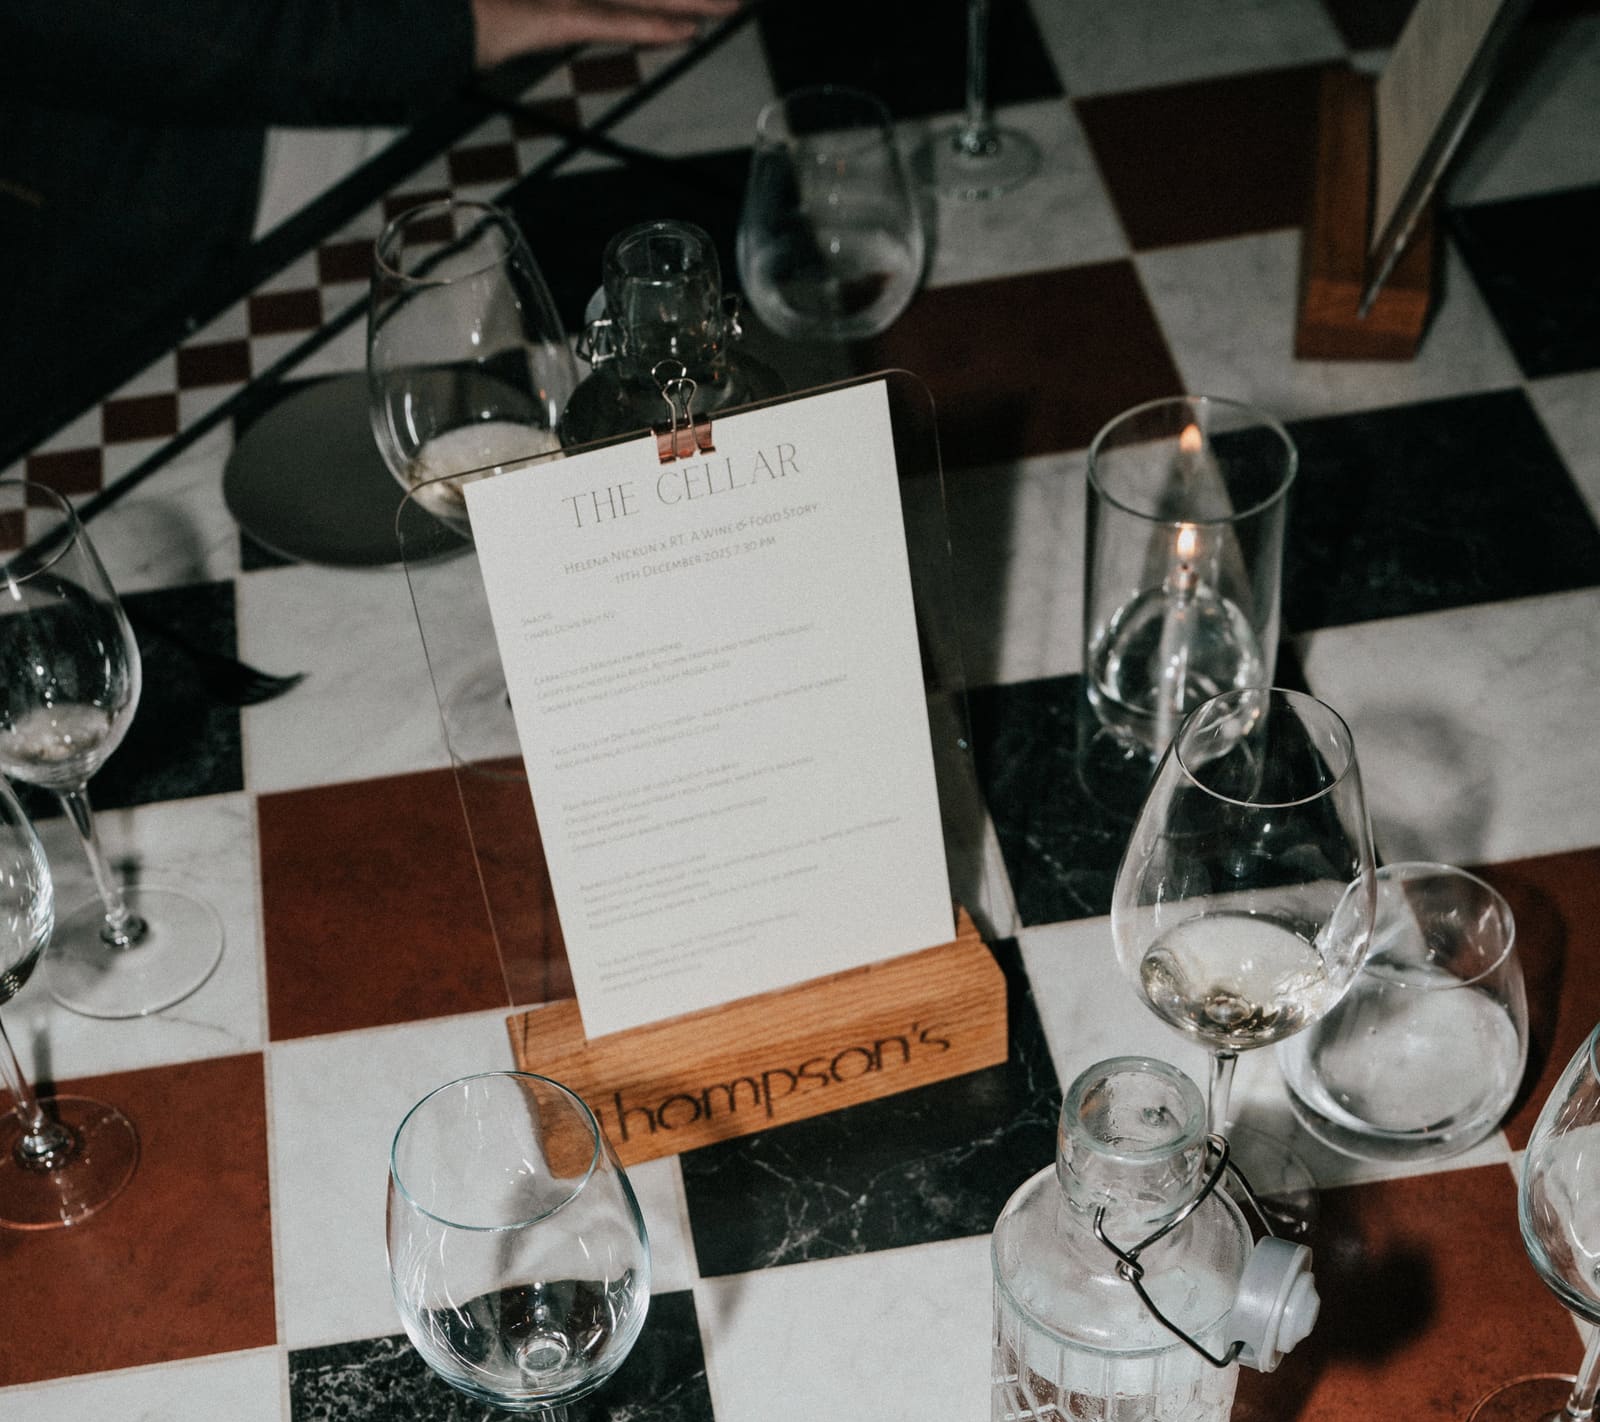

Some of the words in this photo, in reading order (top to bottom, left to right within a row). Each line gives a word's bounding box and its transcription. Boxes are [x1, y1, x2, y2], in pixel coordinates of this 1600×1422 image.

[561, 480, 640, 528] THE
[656, 441, 801, 505] CELLAR
[564, 553, 608, 575] HELENA
[700, 522, 733, 540] WINE
[735, 518, 747, 531] &
[749, 510, 781, 528] FOOD
[782, 500, 818, 520] STORY
[642, 553, 702, 578] DECEMBER
[759, 534, 776, 548] PM
